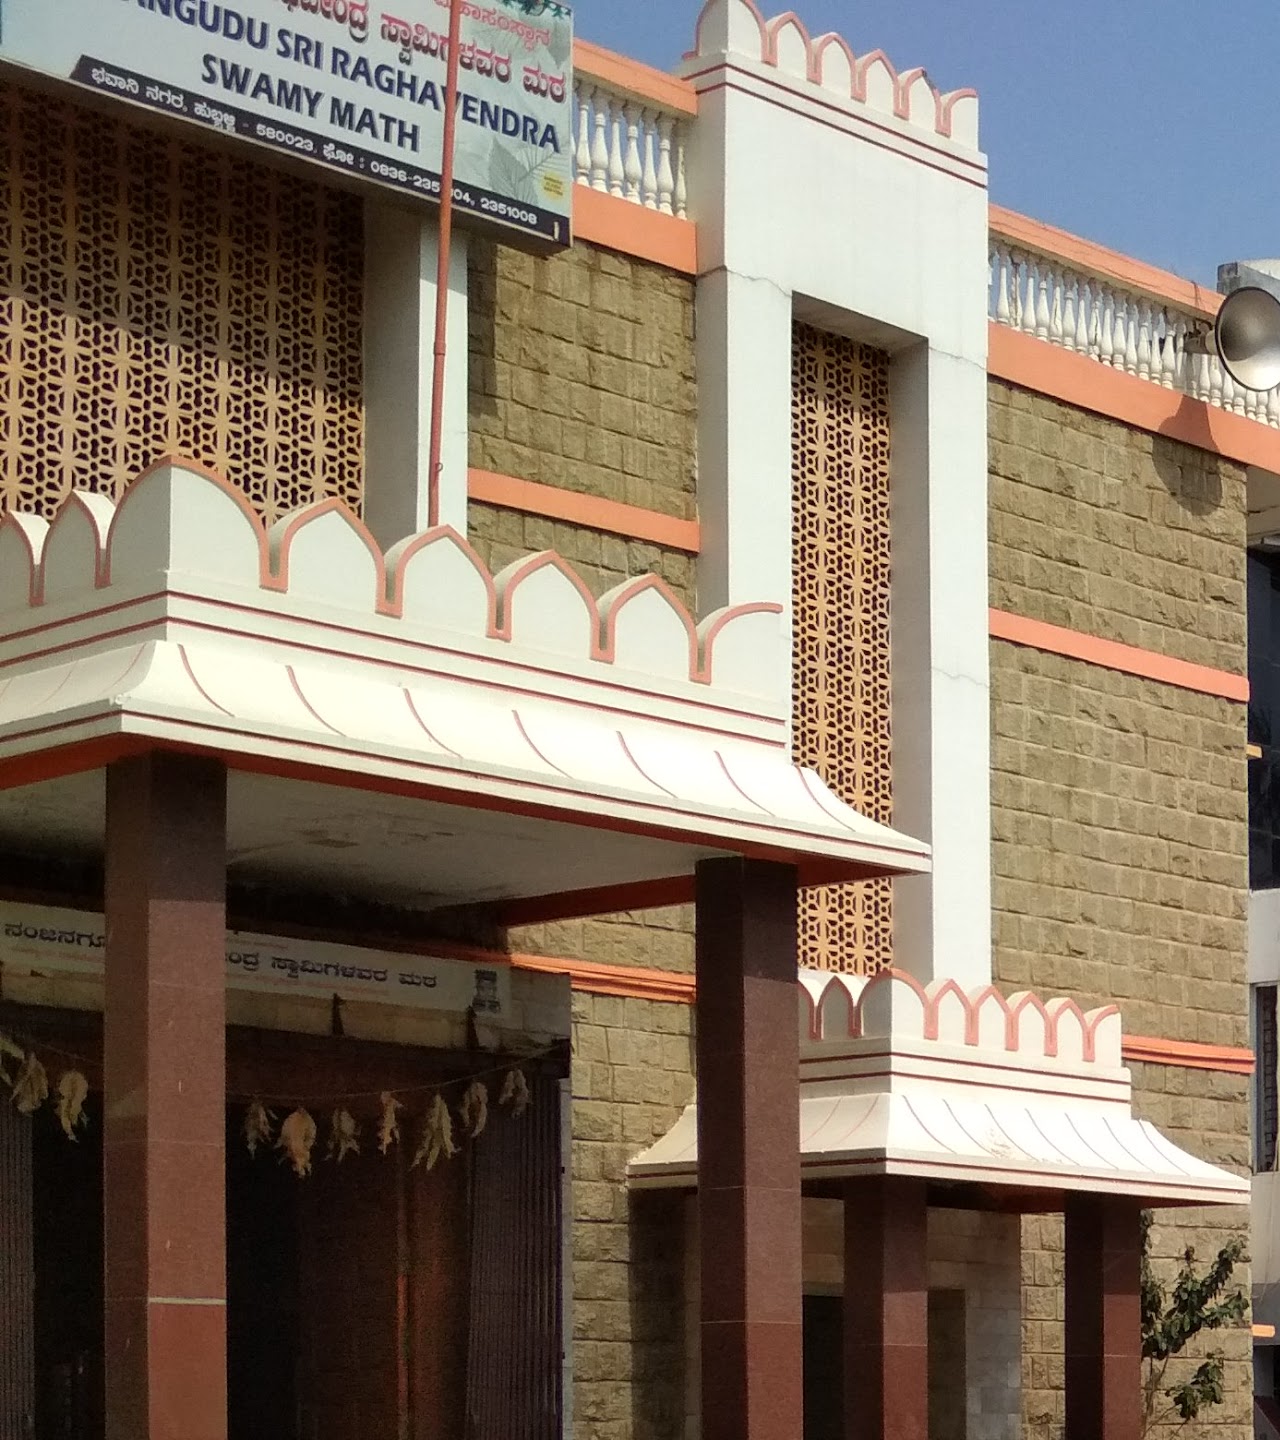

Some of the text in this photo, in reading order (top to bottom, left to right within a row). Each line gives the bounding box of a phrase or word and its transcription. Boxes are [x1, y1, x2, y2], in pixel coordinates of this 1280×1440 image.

[277, 28, 325, 71] SRI
[201, 53, 421, 153] SWAMY MATH
[370, 161, 476, 207] 0836-23504,
[480, 197, 538, 226] 2351008
[4, 922, 105, 948] ನಂಜನಗೂ
